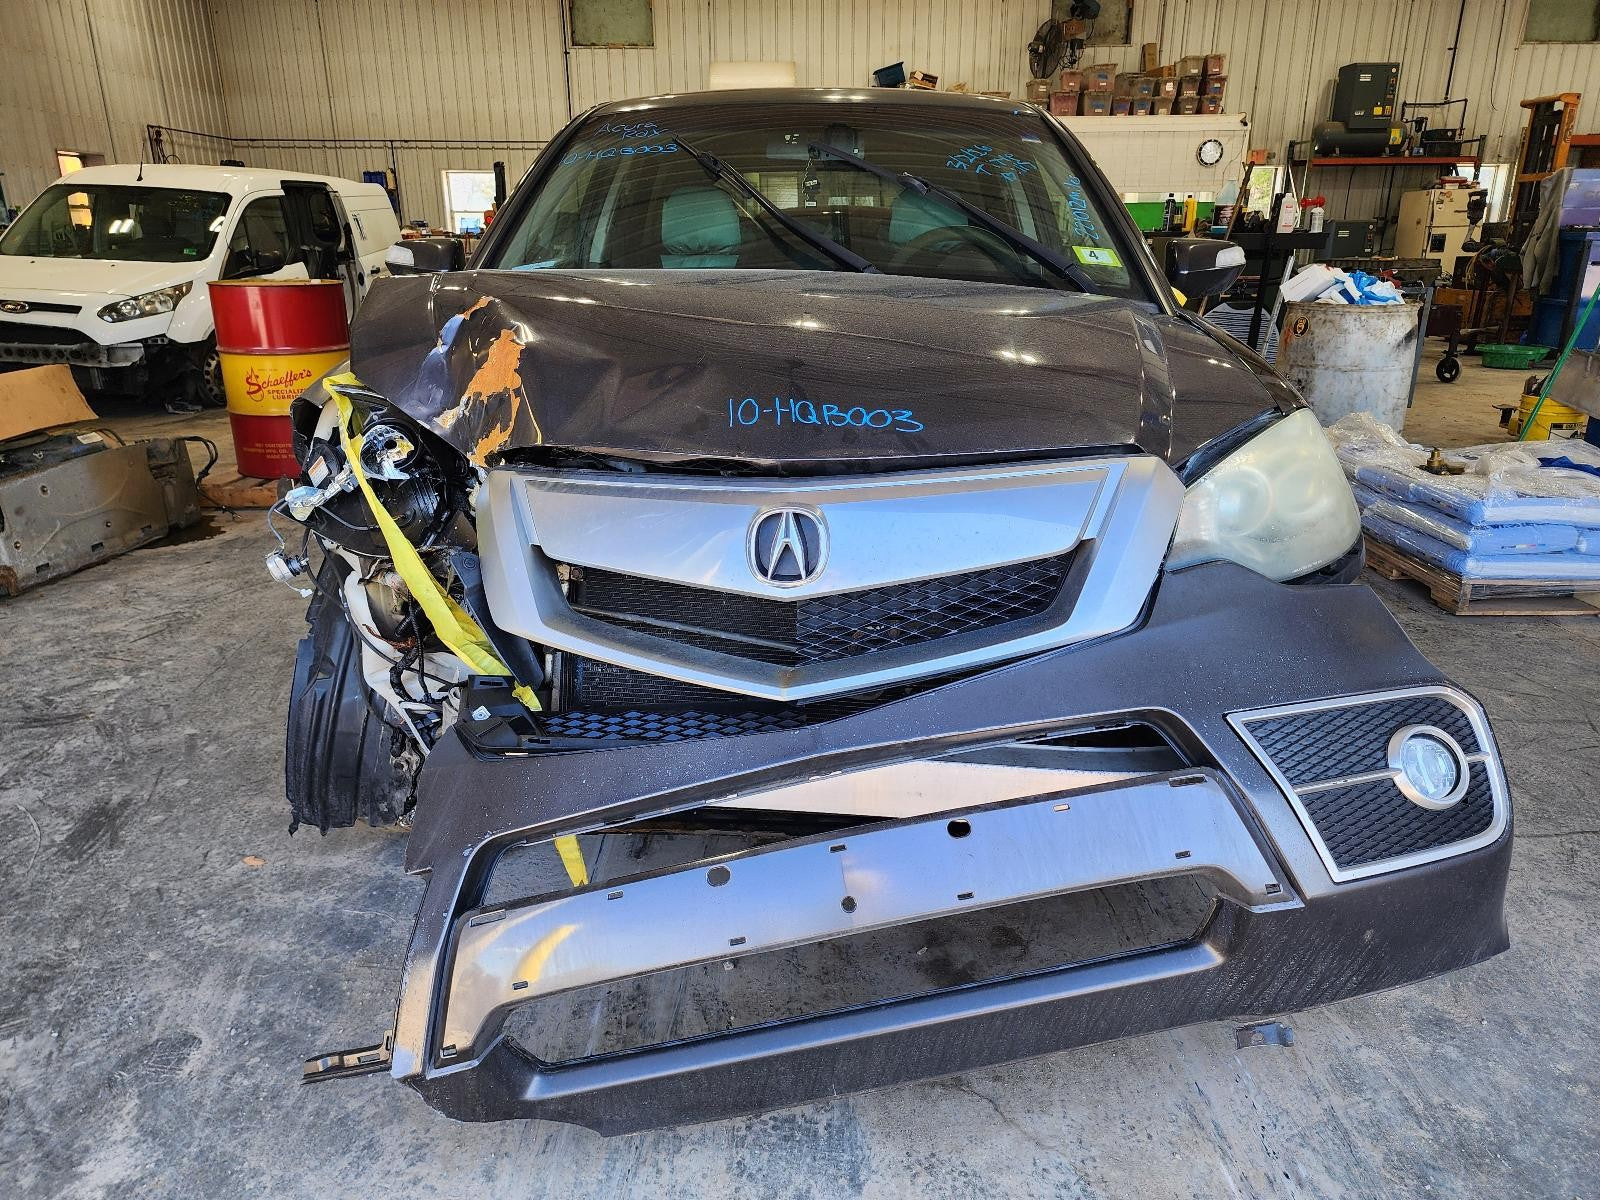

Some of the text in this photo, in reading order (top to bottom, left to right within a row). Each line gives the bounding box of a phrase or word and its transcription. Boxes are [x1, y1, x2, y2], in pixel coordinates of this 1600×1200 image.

[594, 122, 658, 136] Acura
[1088, 250, 1099, 260] 4
[245, 368, 313, 396] Schaeffer's
[729, 397, 925, 432] 10-HQB003
